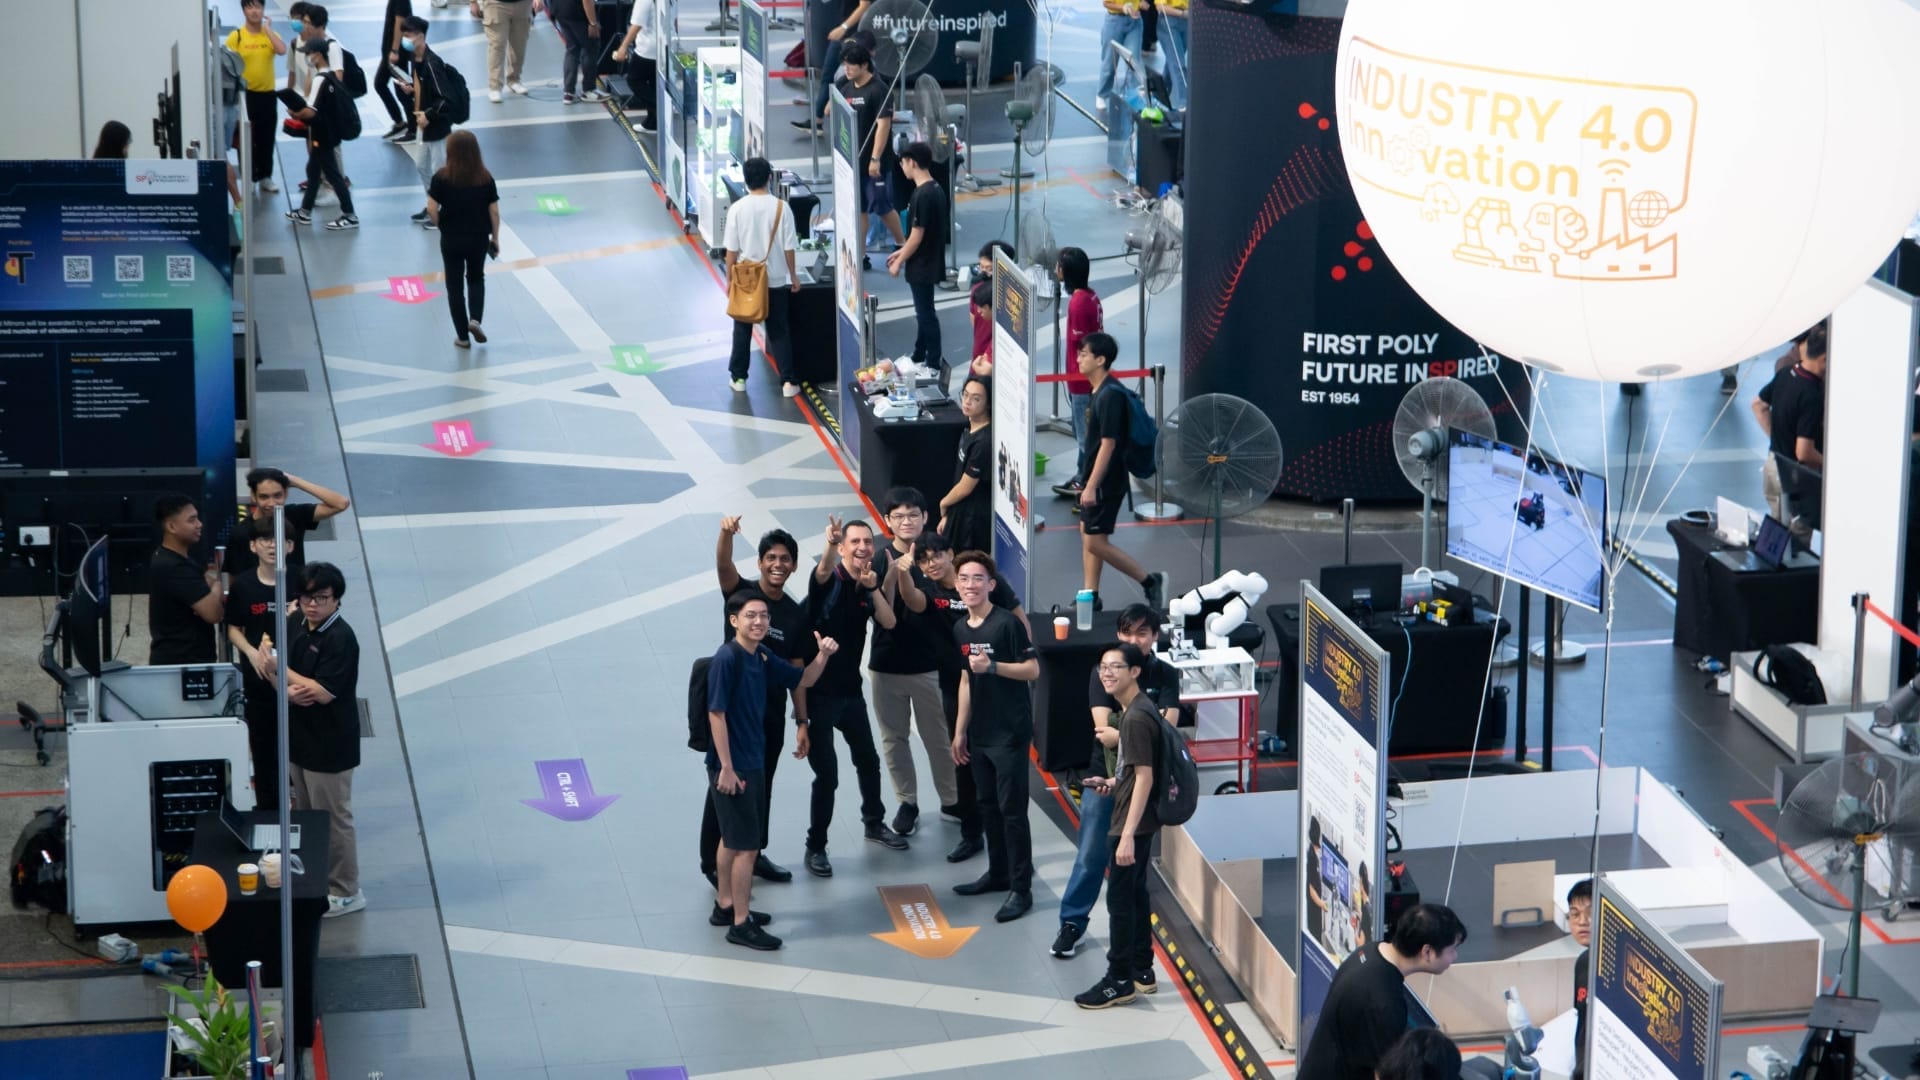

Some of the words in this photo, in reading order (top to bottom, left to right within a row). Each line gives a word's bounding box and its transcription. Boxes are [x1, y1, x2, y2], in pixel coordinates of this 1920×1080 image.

[872, 9, 1007, 35] #futureinspired
[1350, 55, 1563, 143] INDUSTRY
[1580, 105, 1672, 155] 4.0
[1303, 332, 1371, 355] FIRST
[1378, 333, 1439, 355] POLY
[1302, 360, 1398, 384] FUTURE
[1405, 353, 1500, 384] INSPIRED
[1301, 390, 1326, 402] EST
[1329, 392, 1360, 404] 1954
[934, 598, 950, 609] SP
[1324, 641, 1352, 673] INDUSTRY
[1352, 662, 1361, 682] 4.0
[556, 772, 573, 786] CTRL
[562, 791, 580, 808] SHIFT
[1626, 952, 1667, 999] INDUSTRY
[1667, 990, 1681, 1013] 4.0
